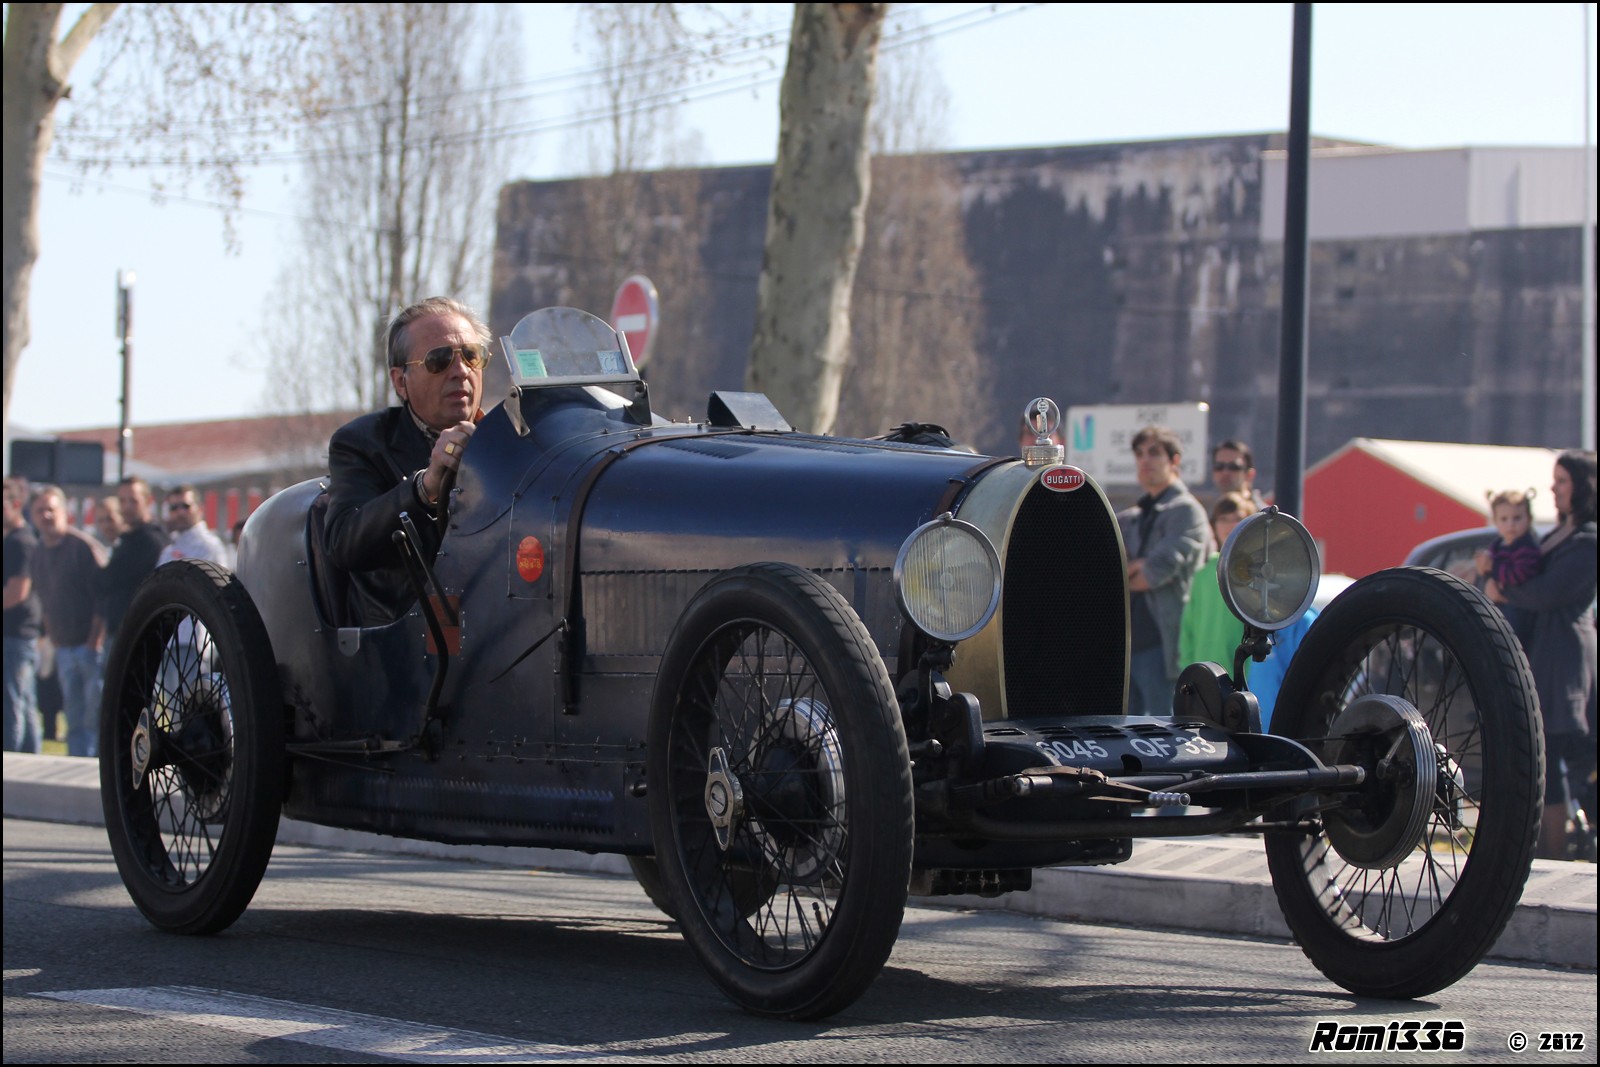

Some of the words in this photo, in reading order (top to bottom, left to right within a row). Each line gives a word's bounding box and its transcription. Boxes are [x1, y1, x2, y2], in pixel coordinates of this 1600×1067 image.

[1047, 475, 1080, 484] BUGATTI
[1036, 740, 1109, 760] 6045
[1129, 737, 1172, 758] QF
[1176, 736, 1216, 755] 33
